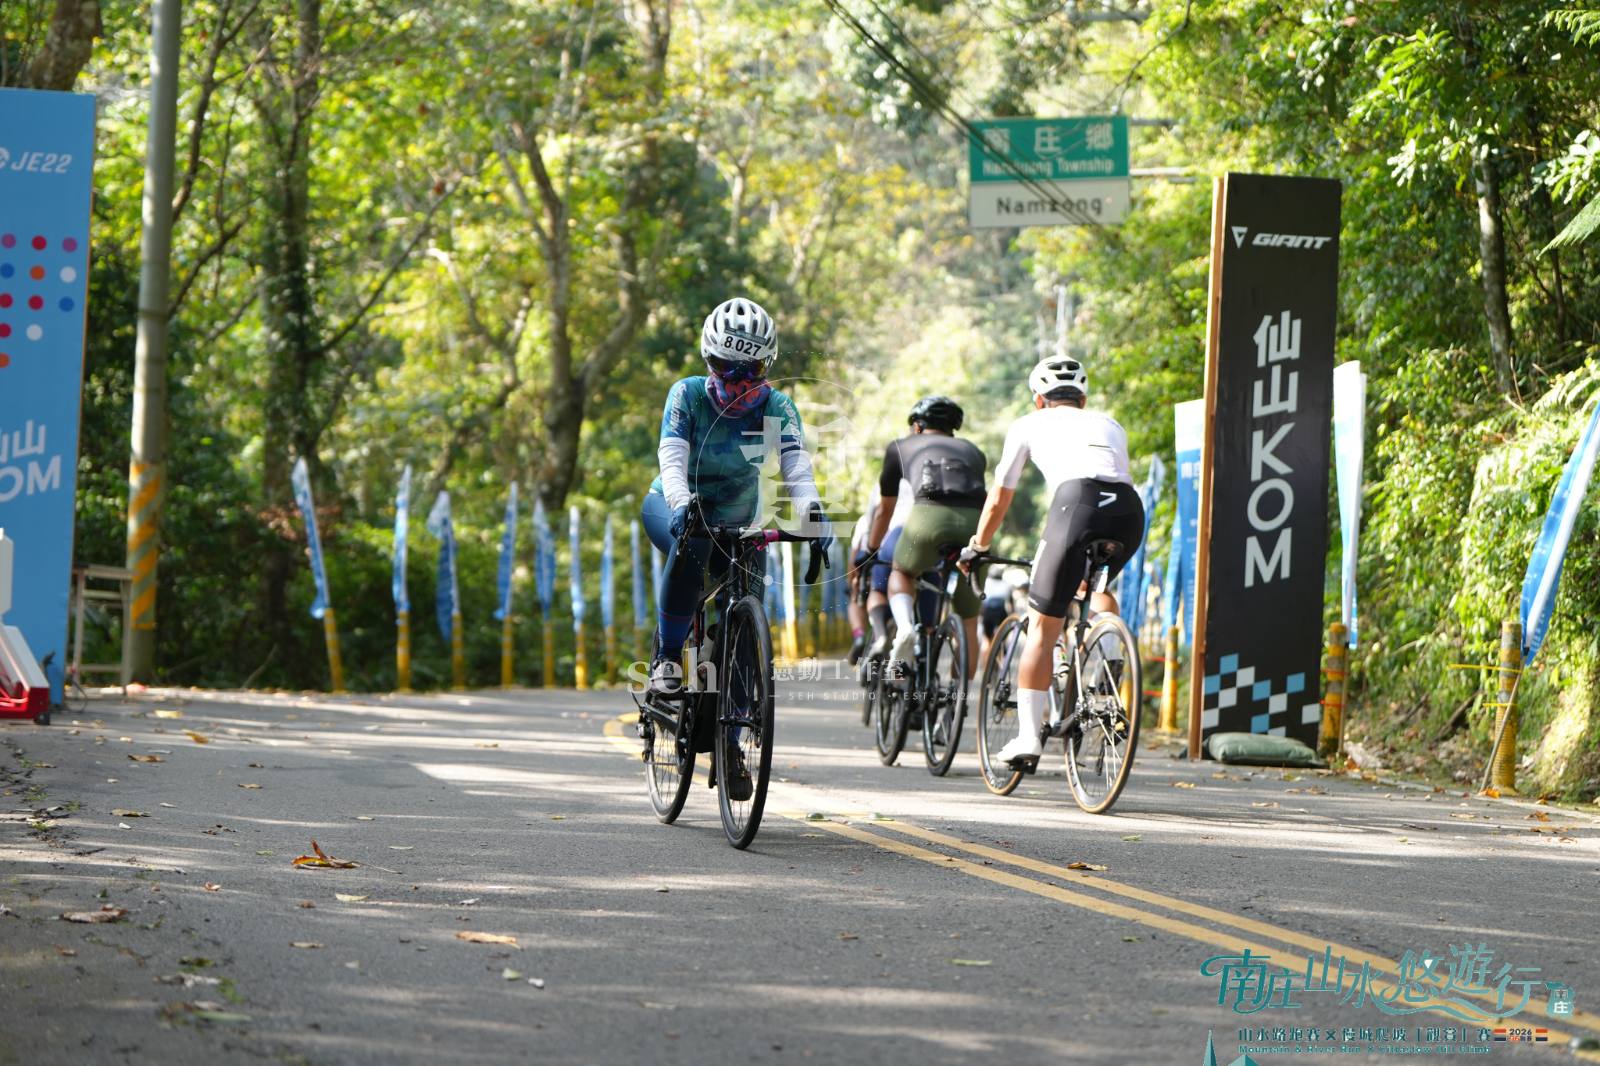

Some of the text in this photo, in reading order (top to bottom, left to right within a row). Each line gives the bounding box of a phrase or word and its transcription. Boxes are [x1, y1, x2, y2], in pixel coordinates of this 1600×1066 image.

[11, 151, 73, 173] JE22
[1057, 156, 1114, 174] Township
[1252, 233, 1332, 249] GIANT
